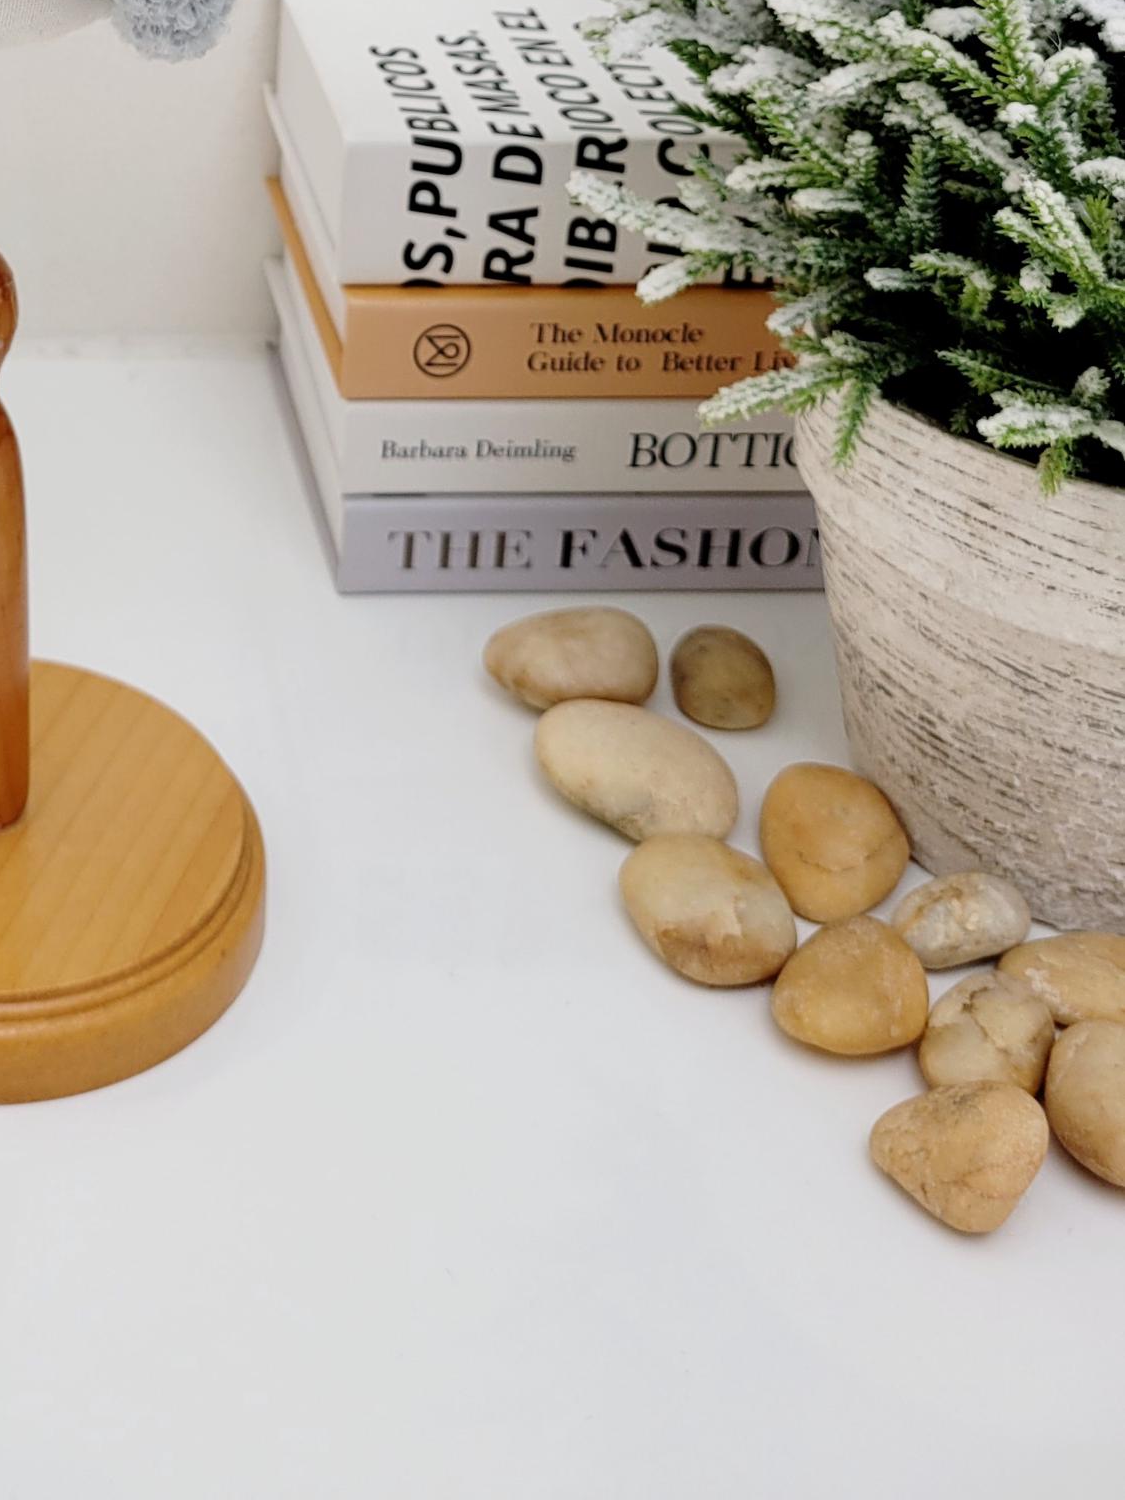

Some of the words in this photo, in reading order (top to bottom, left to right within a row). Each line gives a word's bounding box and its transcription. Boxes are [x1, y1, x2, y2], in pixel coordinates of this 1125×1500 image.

[494, 6, 550, 32] EL
[520, 37, 574, 68] EN
[436, 29, 531, 117] MASAS.
[370, 45, 468, 288] S,PUBLICOS
[487, 122, 545, 186] DE
[483, 206, 541, 286] RA
[530, 322, 583, 344] The
[592, 322, 705, 344] Monocle
[526, 351, 606, 373] Guide
[615, 353, 642, 373] to
[661, 351, 743, 373] Better
[379, 439, 468, 461] Barbara
[475, 438, 578, 463] Deimling
[387, 529, 533, 570] THE
